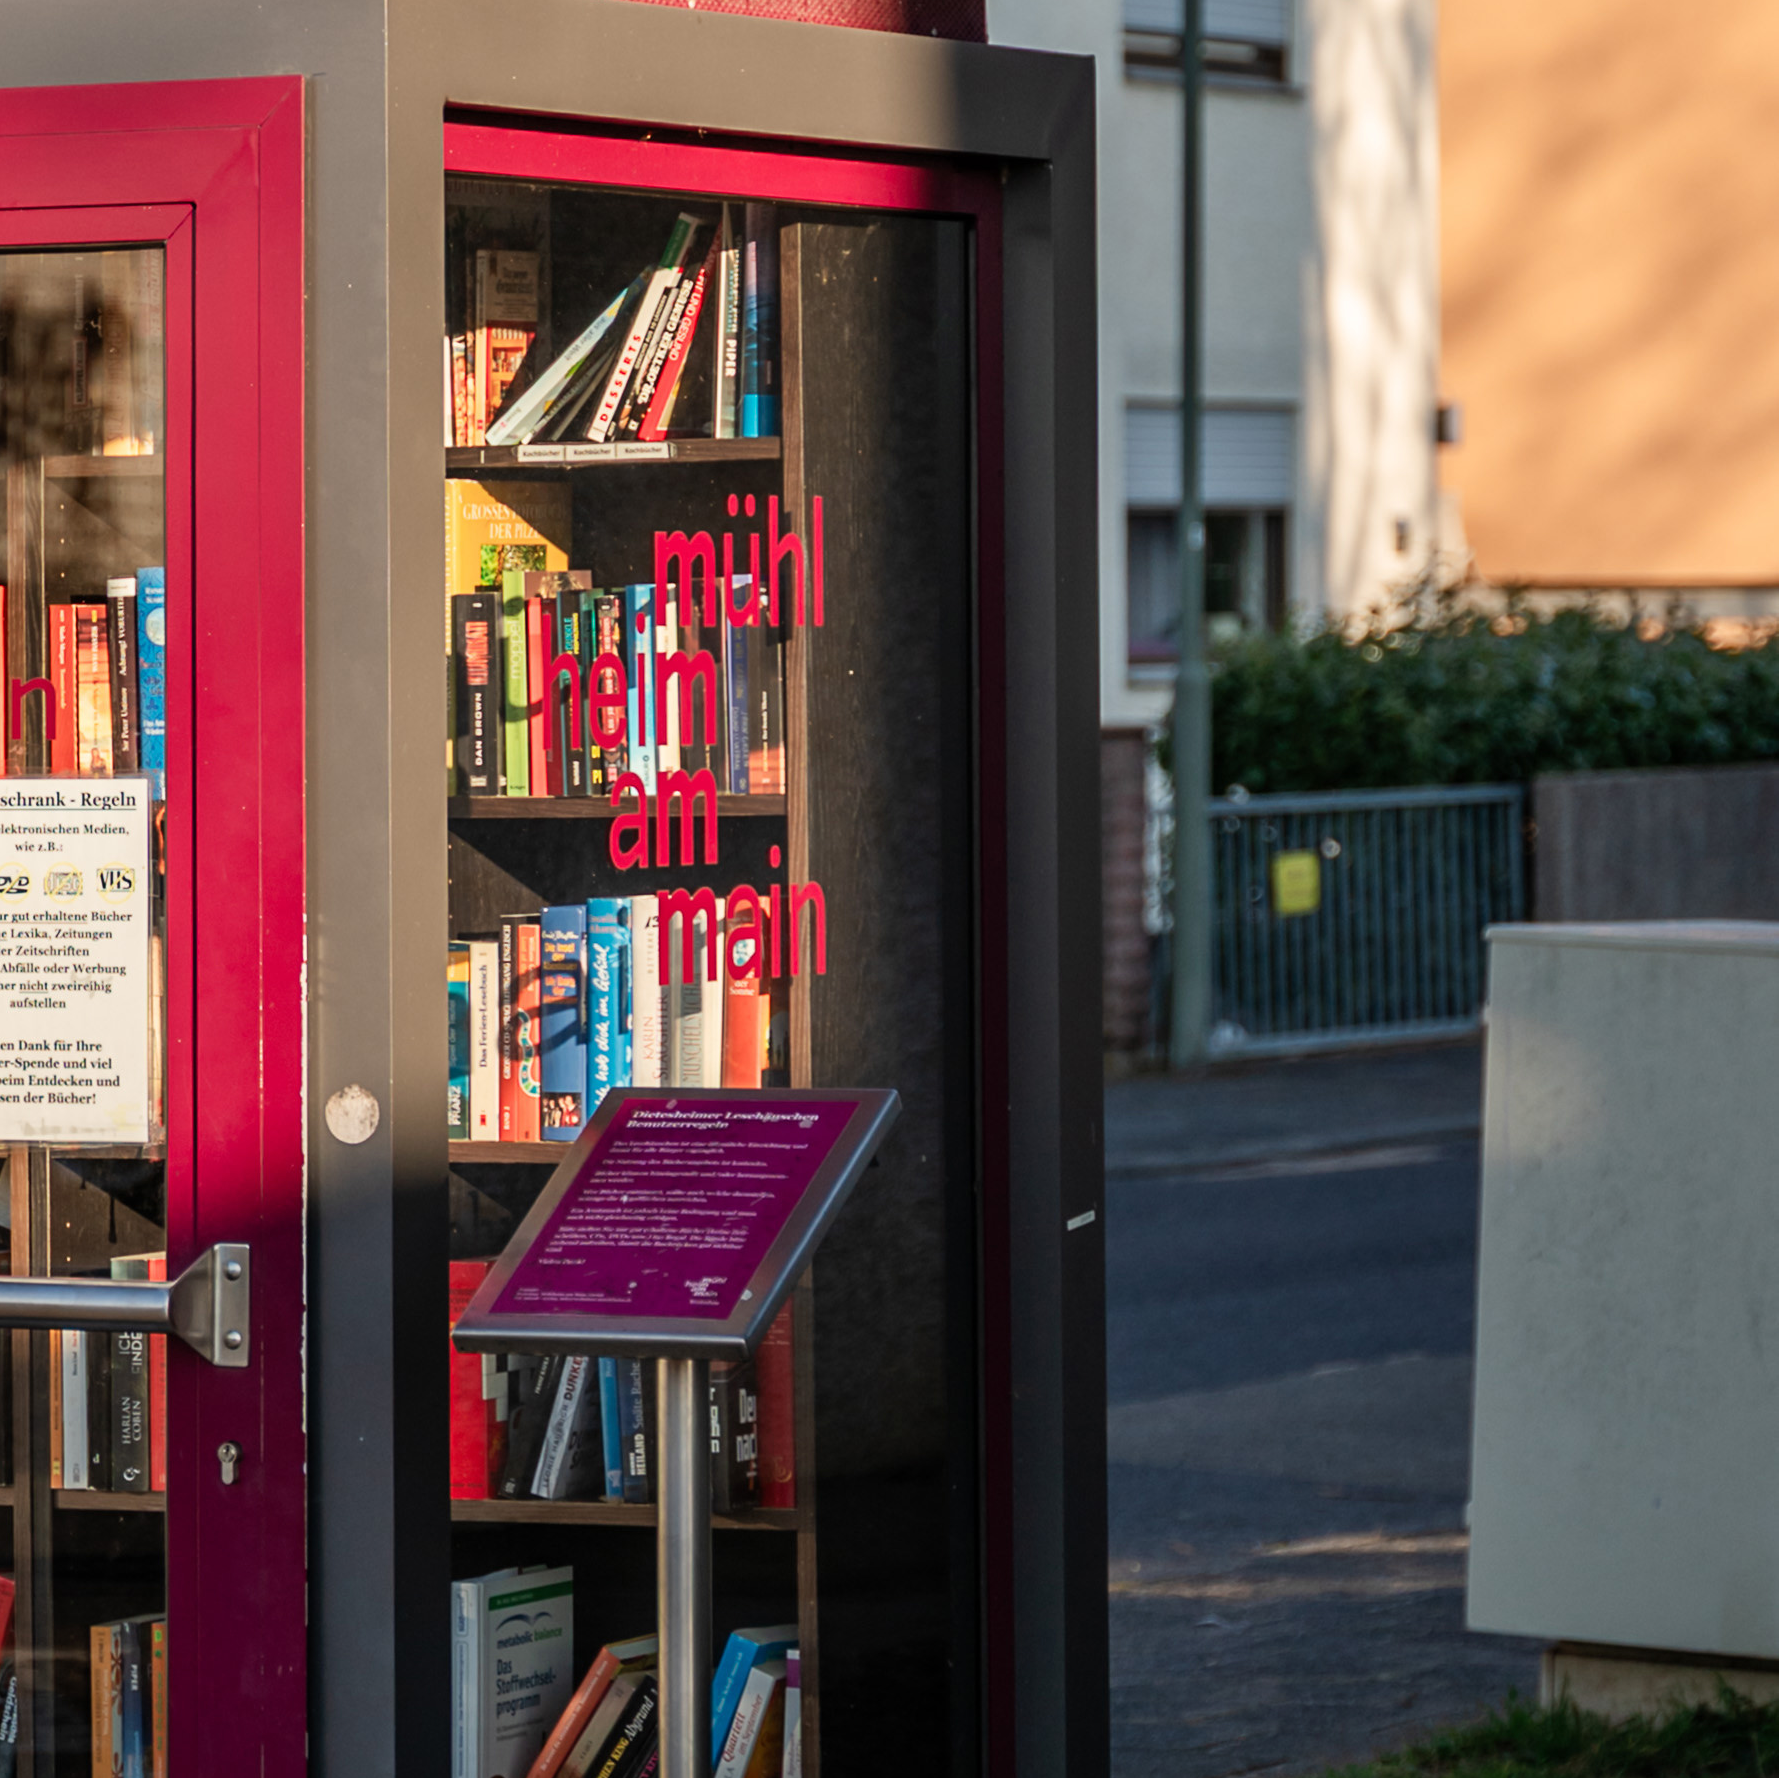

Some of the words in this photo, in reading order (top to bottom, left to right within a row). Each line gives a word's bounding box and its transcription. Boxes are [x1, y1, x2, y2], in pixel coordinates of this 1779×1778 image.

[687, 289, 701, 315] UND
[669, 314, 692, 361] GESUND
[725, 339, 737, 377] PIPER
[600, 333, 642, 422] DESSERTS
[522, 448, 560, 458] Kochbücher
[573, 447, 611, 456] Kochbücher
[625, 446, 663, 455] Kochbücher
[463, 503, 510, 520] GROSSES
[490, 523, 513, 539] DER
[655, 493, 824, 627] mühl
[118, 641, 127, 675] Achtung!
[542, 612, 718, 751] heim
[120, 687, 129, 717] Ustinov
[474, 693, 483, 736] BROWN
[121, 718, 129, 739] Peter
[121, 740, 129, 751] Sir
[474, 739, 483, 766] DAN
[80, 792, 136, 810] Regeln
[83, 824, 130, 836] Medien,
[609, 769, 719, 869] am
[15, 842, 35, 852] wie
[38, 841, 64, 852] z.B.:
[100, 869, 133, 890] VHS
[11, 912, 30, 923] gut
[33, 911, 88, 922] erhaltene
[91, 911, 133, 922] Bücher
[658, 845, 826, 985] main
[10, 929, 52, 941] Lexika,
[55, 929, 113, 941] Zeitungen
[503, 924, 511, 962] ENGLISCH
[15, 945, 90, 956] Zeitschriften
[0, 963, 40, 974] Abfälle
[43, 963, 70, 974] oder
[73, 963, 127, 976] Werbung
[591, 942, 610, 992] Gefühl
[19, 980, 48, 991] nicht
[51, 981, 112, 993] zweireihig
[729, 987, 755, 997] Sonne
[10, 998, 66, 1009] aufstellen
[479, 964, 488, 1047] Ferien-Lesebuch
[594, 995, 609, 1017] im
[18, 1040, 50, 1051] Dank
[53, 1040, 74, 1052] für
[76, 1040, 102, 1052] Ihre
[593, 1022, 610, 1052] dich
[642, 1016, 655, 1060] KARIN
[654, 994, 670, 1080] SLAUGHTER
[63, 1058, 87, 1069] und
[90, 1058, 112, 1069] viel
[479, 1048, 488, 1068] Das
[503, 1044, 512, 1079] GROSSER
[592, 1055, 609, 1081] hab
[28, 1075, 93, 1086] Entdecken
[96, 1076, 120, 1087] und
[23, 1092, 45, 1103] der
[48, 1092, 96, 1104] Bücher!
[626, 1120, 729, 1131] Benutzerregeln
[632, 1110, 723, 1121] Dietesheimer
[724, 1111, 820, 1123] Lesehäuschen
[630, 1362, 641, 1396] Rache
[121, 1397, 131, 1445] HARLAN
[132, 1400, 142, 1441] COBEN
[632, 1397, 644, 1429] Späte
[635, 1433, 646, 1476] HEILAND
[497, 1630, 533, 1649] metabolic
[534, 1627, 562, 1642] balance
[130, 1663, 139, 1692] PIPER
[496, 1659, 512, 1675] Das
[496, 1668, 556, 1695] Stoffwechsel-
[496, 1693, 540, 1719] programm
[741, 1693, 763, 1745] September
[610, 1737, 630, 1765] KING
[623, 1695, 654, 1743] Abgrund
[722, 1712, 745, 1763] Quartett
